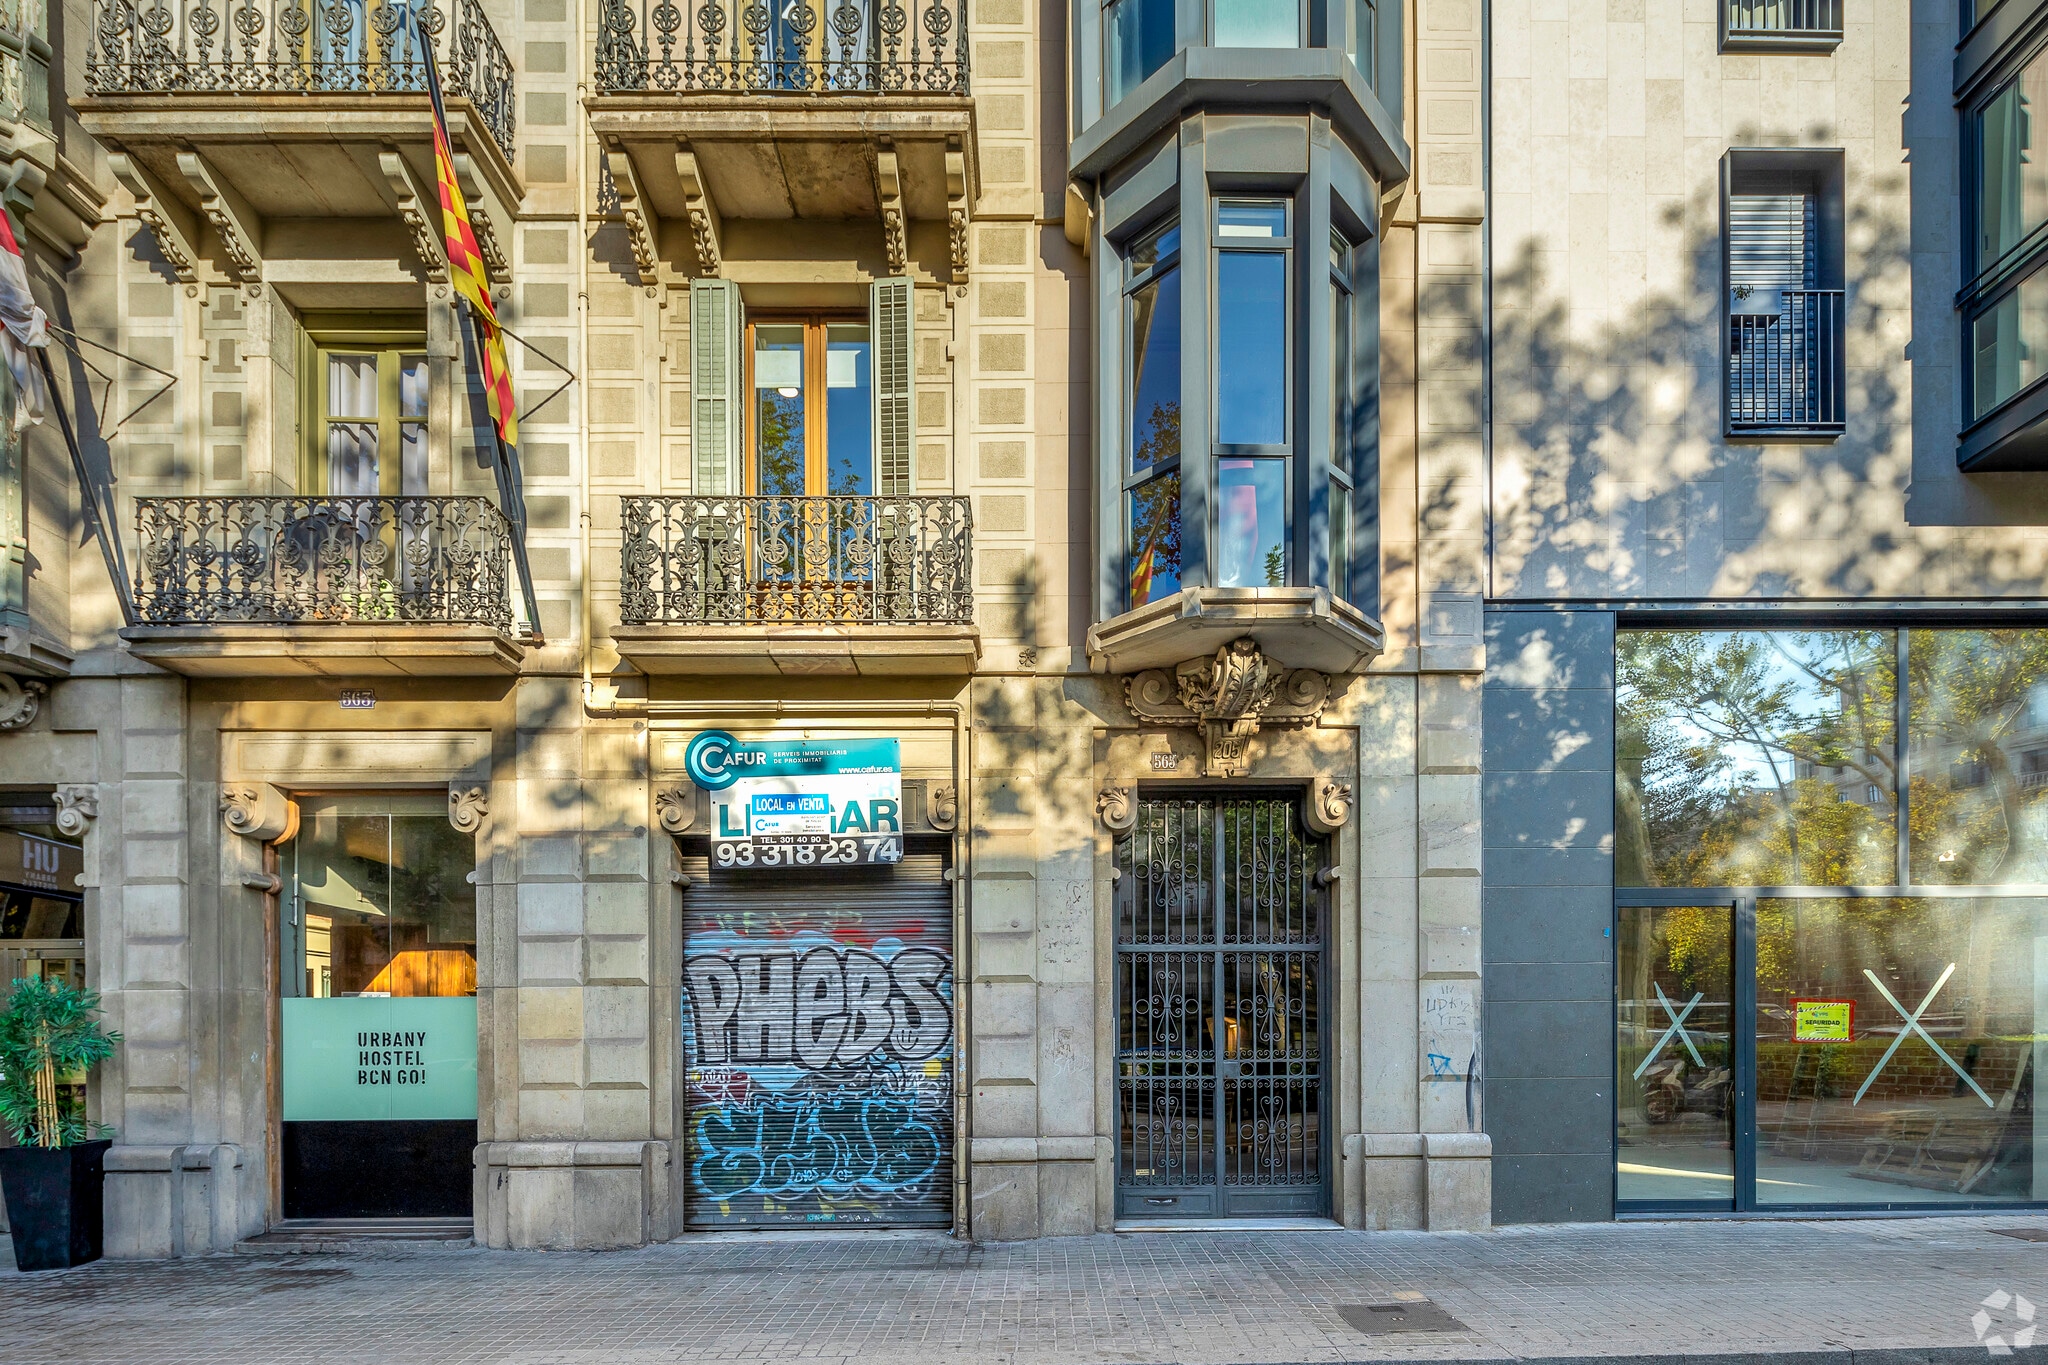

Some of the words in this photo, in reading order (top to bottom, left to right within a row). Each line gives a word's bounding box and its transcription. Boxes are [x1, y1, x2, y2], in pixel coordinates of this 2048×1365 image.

[342, 691, 371, 706] 563
[1213, 740, 1241, 759] 205
[700, 746, 767, 774] CAFUR
[1154, 754, 1177, 769] 565
[838, 765, 893, 774] www.cafur.es
[755, 798, 784, 812] LOCAL
[786, 801, 796, 811] EN
[797, 797, 825, 811] VENTA
[760, 836, 777, 844] TEL.
[716, 842, 756, 867] 93
[761, 843, 816, 866] 318
[820, 839, 859, 864] 23
[863, 838, 900, 862] 74
[357, 1031, 426, 1047] URBANY
[359, 1050, 425, 1066] HOSTEL
[357, 1069, 391, 1085] BCN
[397, 1069, 426, 1085] GO!
